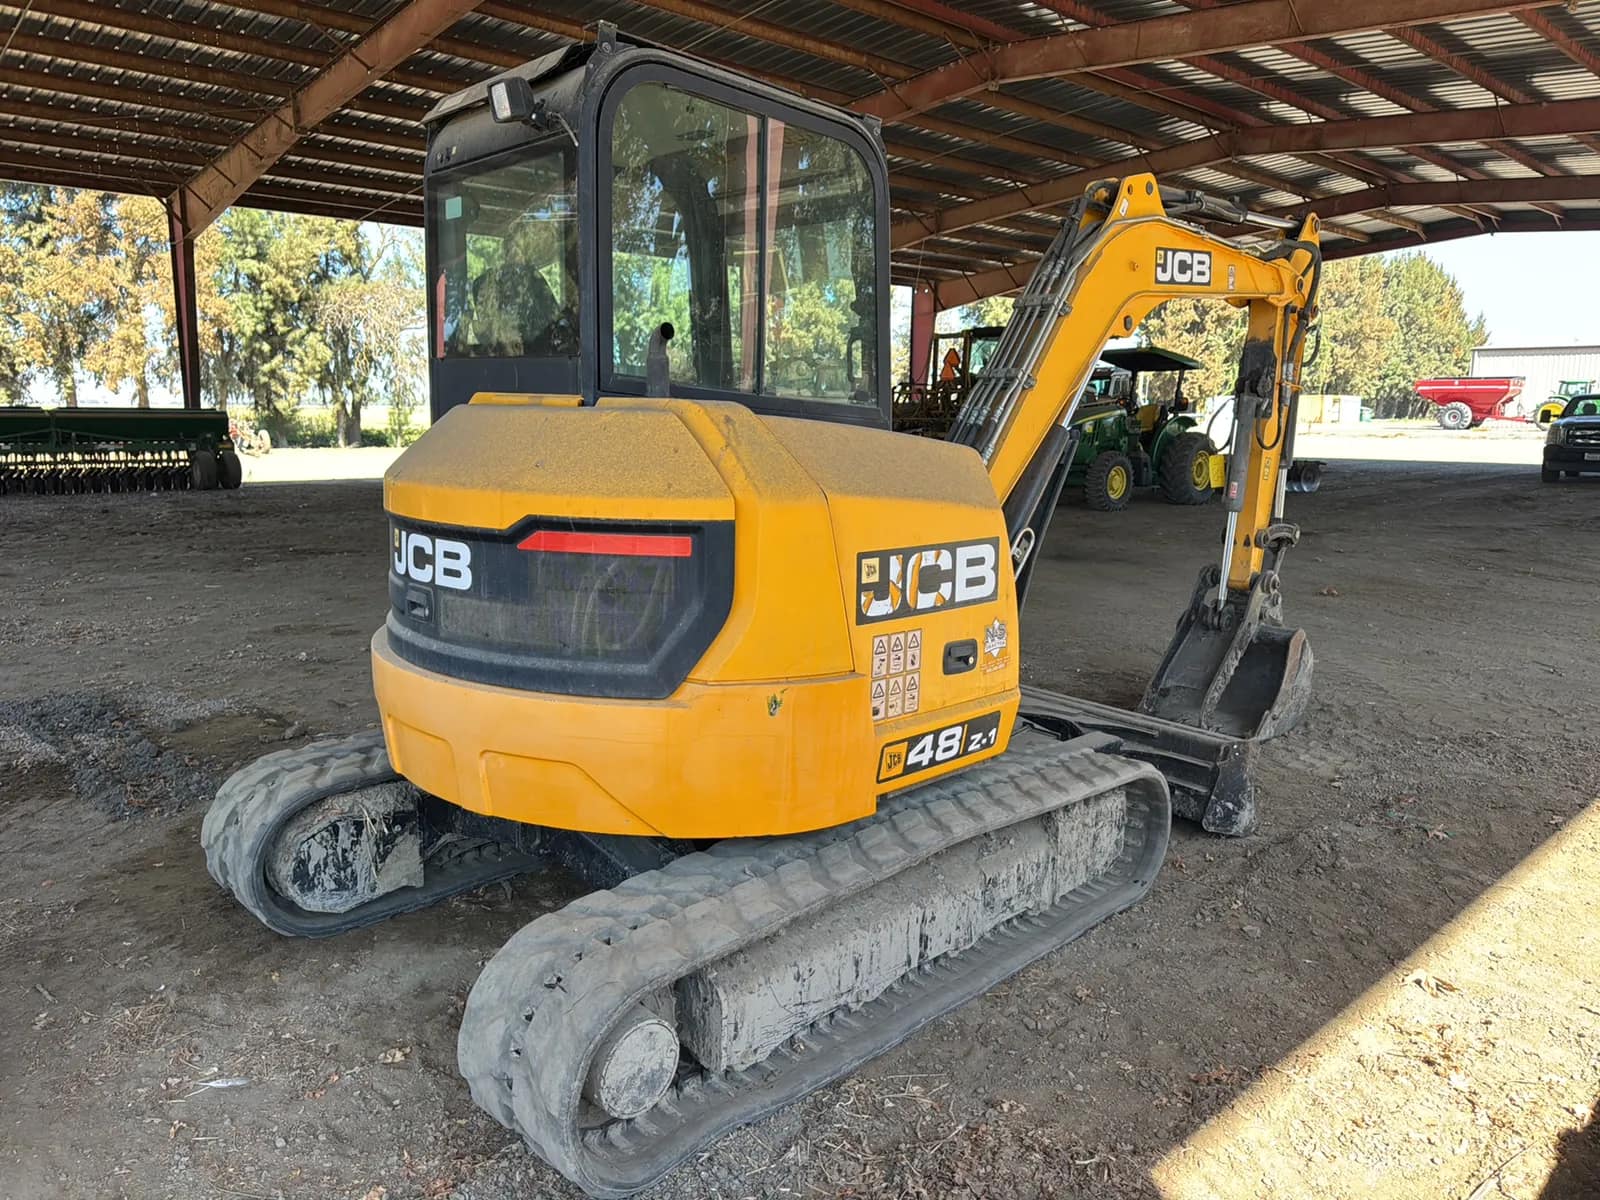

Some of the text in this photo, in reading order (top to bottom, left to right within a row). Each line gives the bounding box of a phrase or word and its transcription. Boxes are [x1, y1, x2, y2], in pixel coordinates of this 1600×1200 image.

[1156, 250, 1210, 283] JCB
[394, 530, 472, 590] JCB
[861, 543, 996, 617] JCB
[887, 752, 902, 770] JCB
[906, 726, 963, 767] 48
